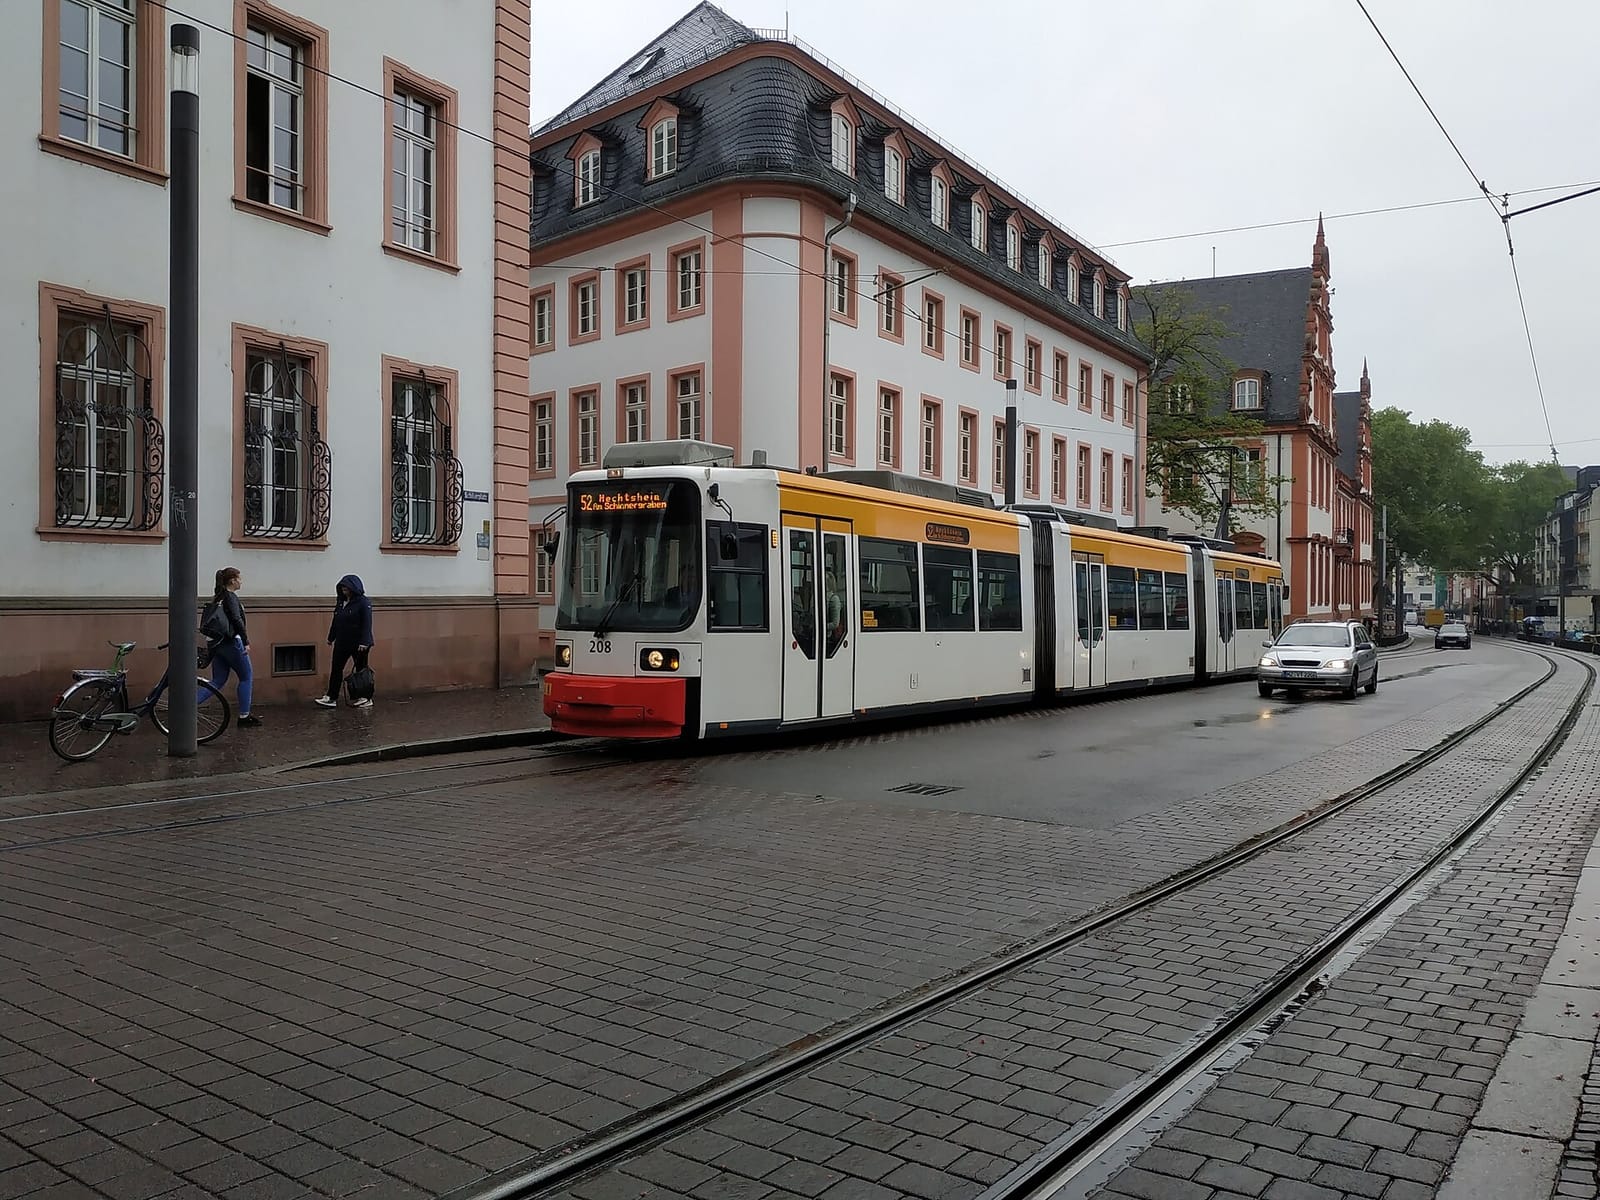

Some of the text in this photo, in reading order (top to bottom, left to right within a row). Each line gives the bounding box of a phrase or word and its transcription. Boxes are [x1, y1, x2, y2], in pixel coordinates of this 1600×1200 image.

[580, 494, 593, 511] 52
[598, 492, 660, 503] Hechtsheim
[589, 640, 612, 653] 208
